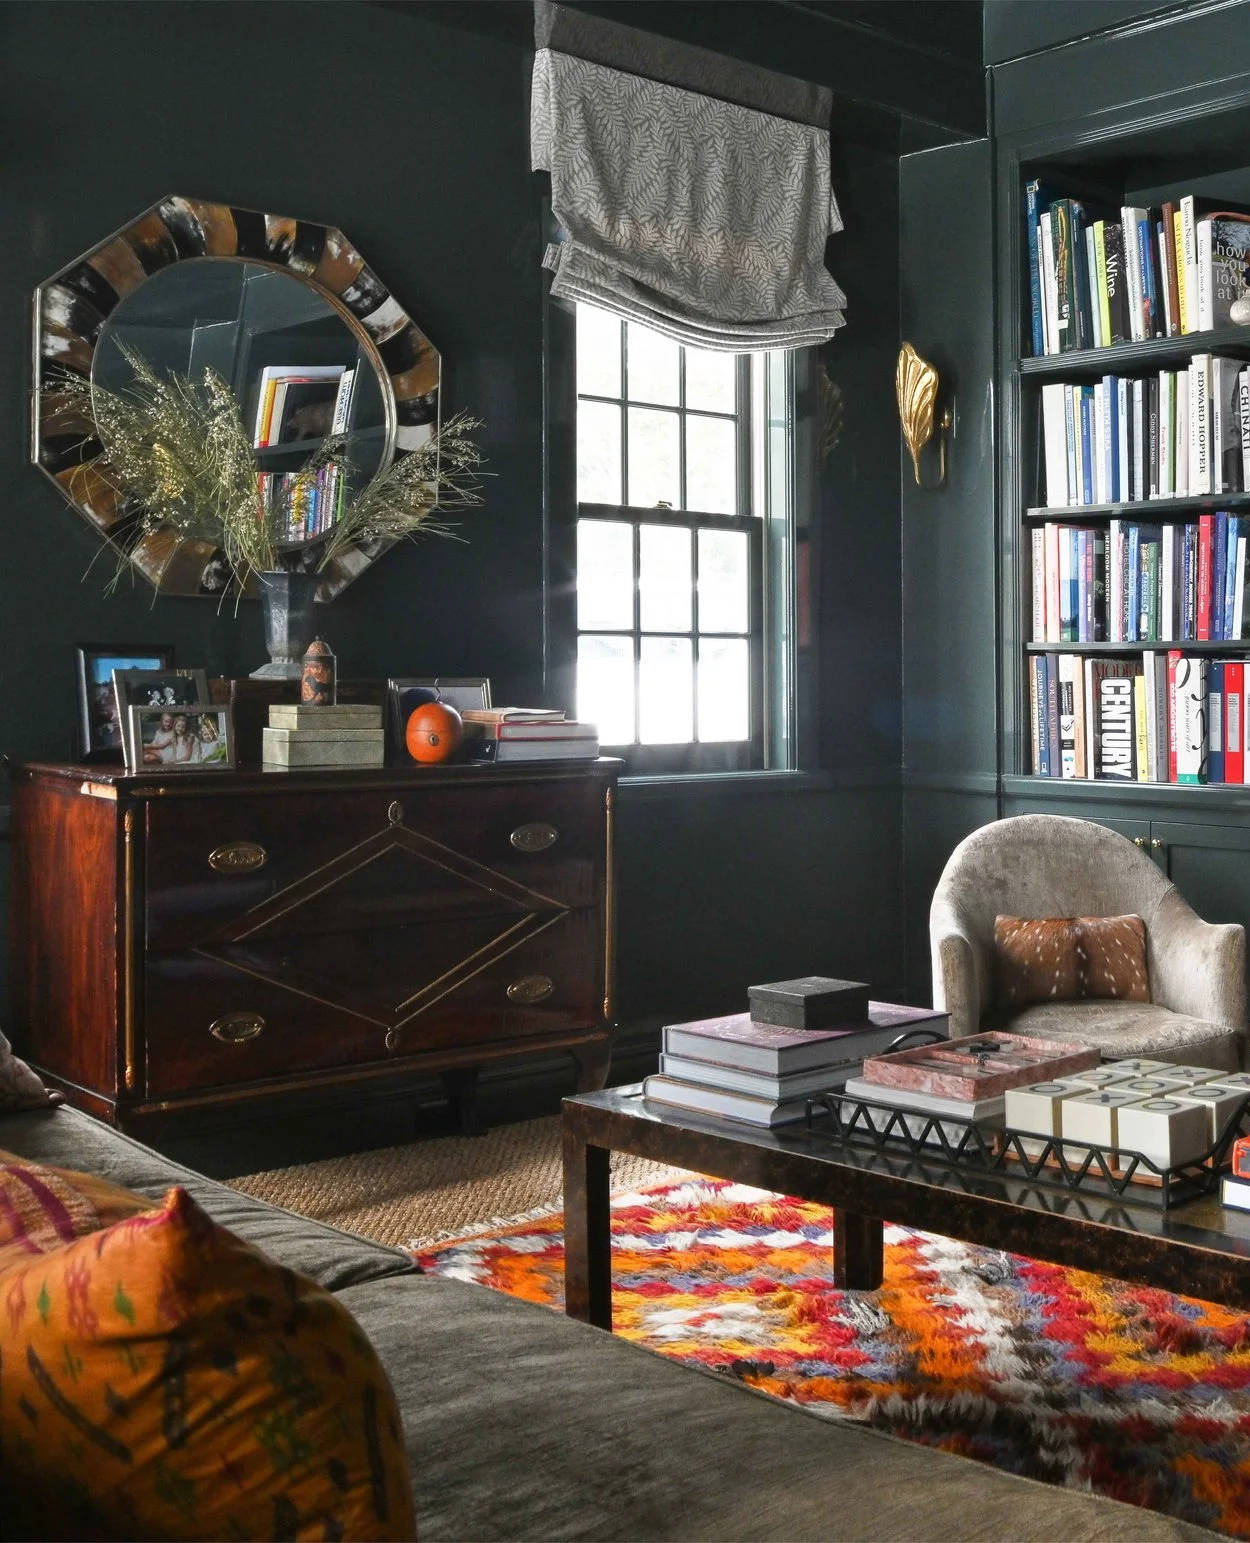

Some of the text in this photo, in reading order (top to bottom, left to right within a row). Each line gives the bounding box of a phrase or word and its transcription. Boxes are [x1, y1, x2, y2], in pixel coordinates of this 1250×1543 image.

[1183, 201, 1193, 266] Isamu Noguchi
[1216, 241, 1247, 259] how
[1105, 253, 1118, 298] Wine
[1216, 270, 1246, 287] look
[1220, 258, 1246, 273] you
[1031, 286, 1040, 319] WORLD
[1217, 287, 1231, 300] at
[1197, 371, 1206, 474] EDWARD HOPPER
[1123, 588, 1129, 600] AT
[1049, 679, 1057, 709] SOUTH
[1100, 679, 1132, 778] CENTURY
